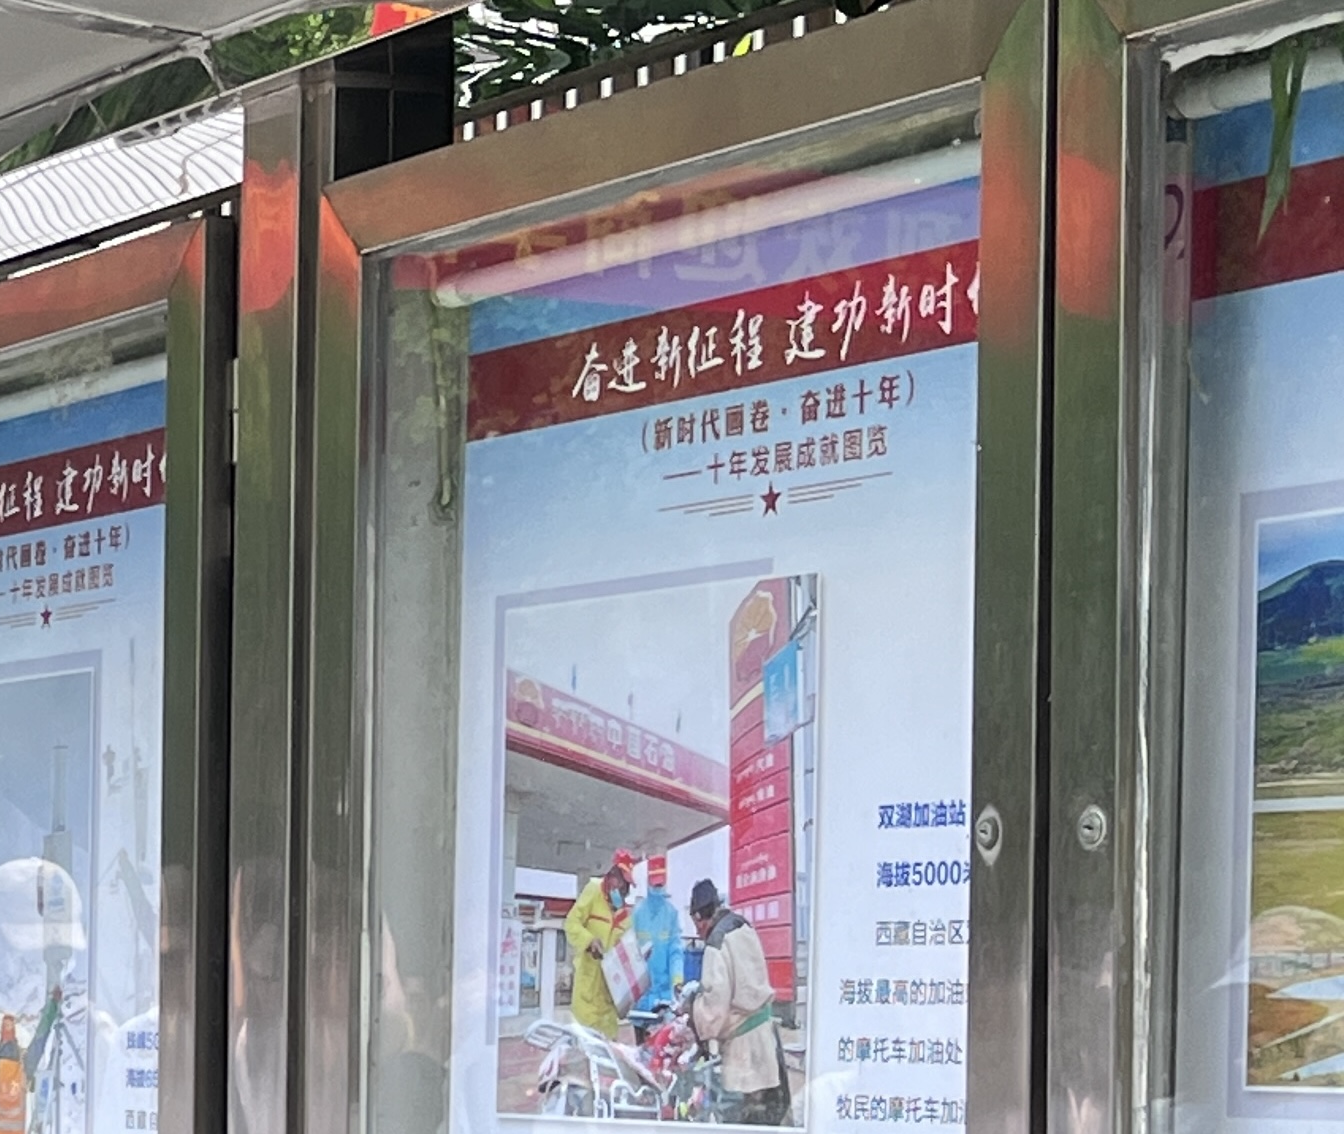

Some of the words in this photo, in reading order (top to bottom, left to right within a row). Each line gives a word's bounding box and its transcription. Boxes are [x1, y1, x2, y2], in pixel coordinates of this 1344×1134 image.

[572, 308, 763, 401] 奋进新征程
[878, 799, 966, 830] 双湖加油站
[875, 919, 970, 946] 西藏自治区
[839, 977, 968, 1006] 海拔最高的加油
